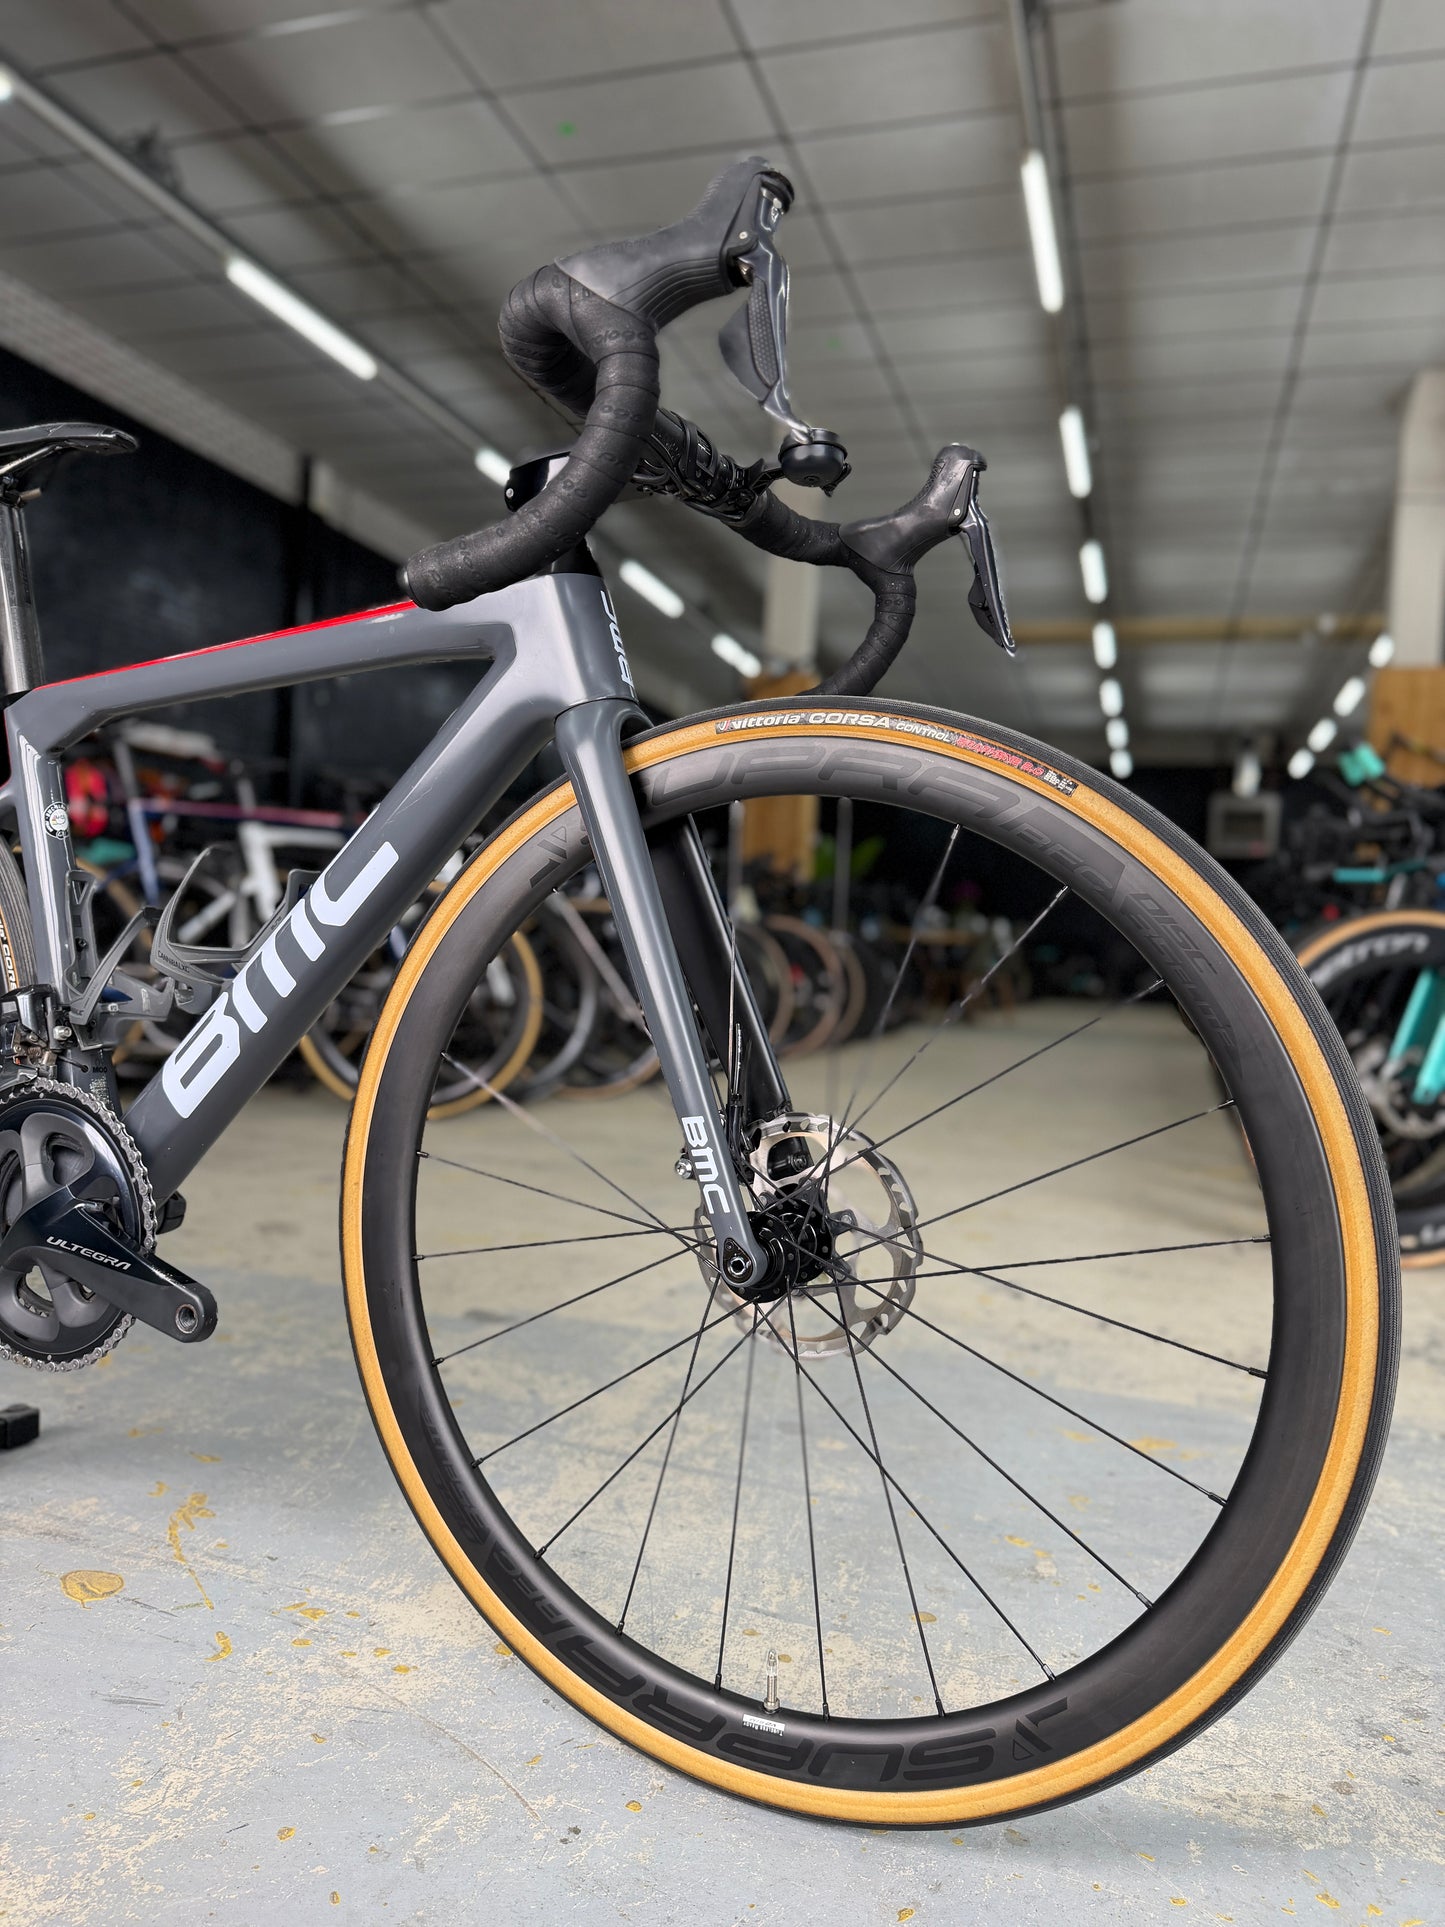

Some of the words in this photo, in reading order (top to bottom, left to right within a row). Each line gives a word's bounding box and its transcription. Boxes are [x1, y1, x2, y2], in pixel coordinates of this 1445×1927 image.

[808, 711, 892, 730] CORSA
[895, 721, 951, 744] CONTROL
[162, 803, 400, 1119] BMC
[681, 1115, 731, 1214] BMC
[46, 1235, 132, 1271] ULTEGRA
[555, 1633, 999, 1784] SUPRA
